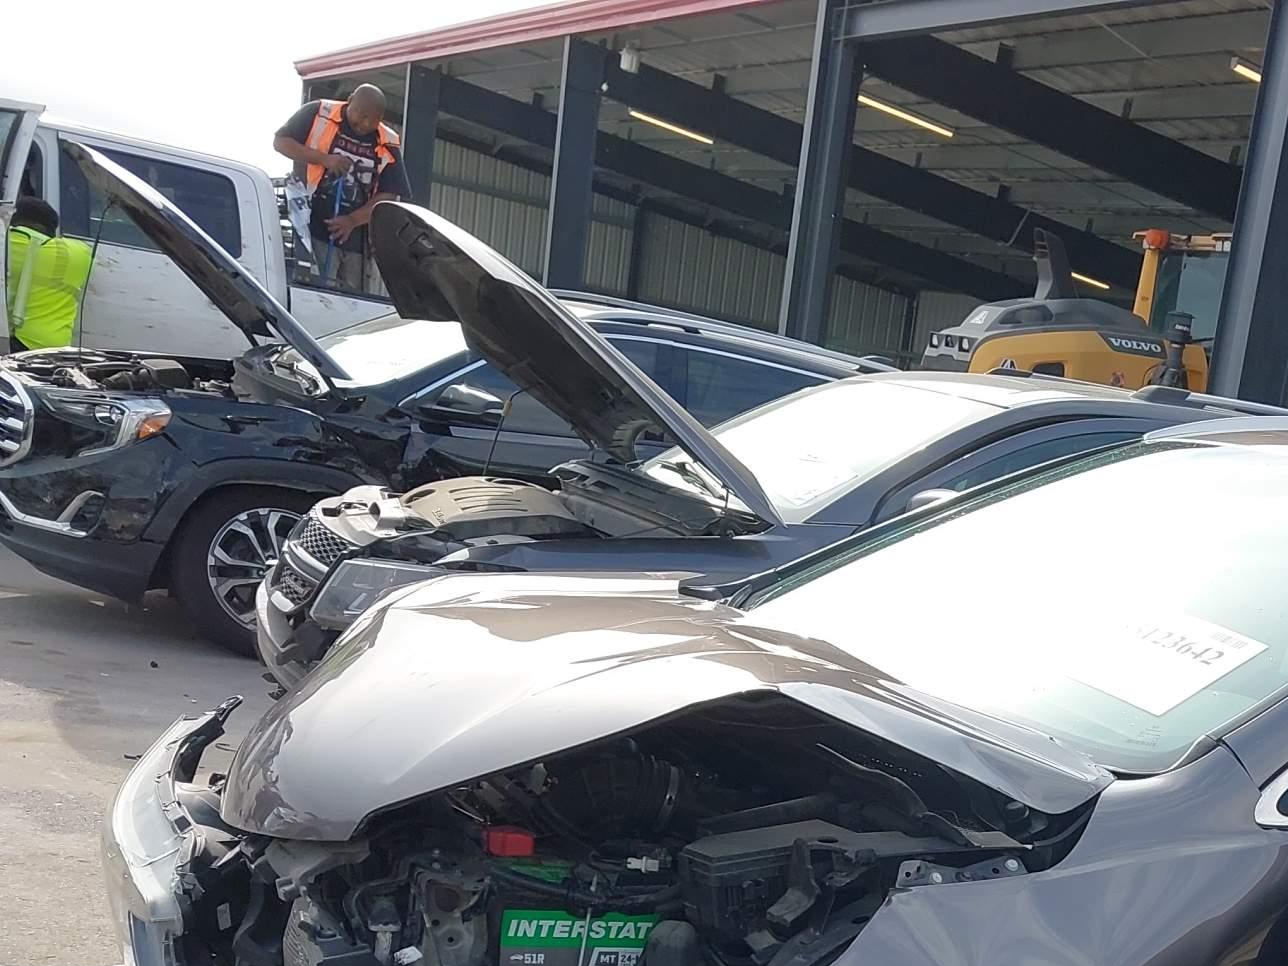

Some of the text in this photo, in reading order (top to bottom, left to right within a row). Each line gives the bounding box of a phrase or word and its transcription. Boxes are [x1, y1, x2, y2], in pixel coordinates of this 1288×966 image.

[1108, 337, 1162, 353] VOLVO
[1134, 623, 1225, 667] 123642
[524, 953, 545, 965] 51R
[600, 954, 616, 965] MT
